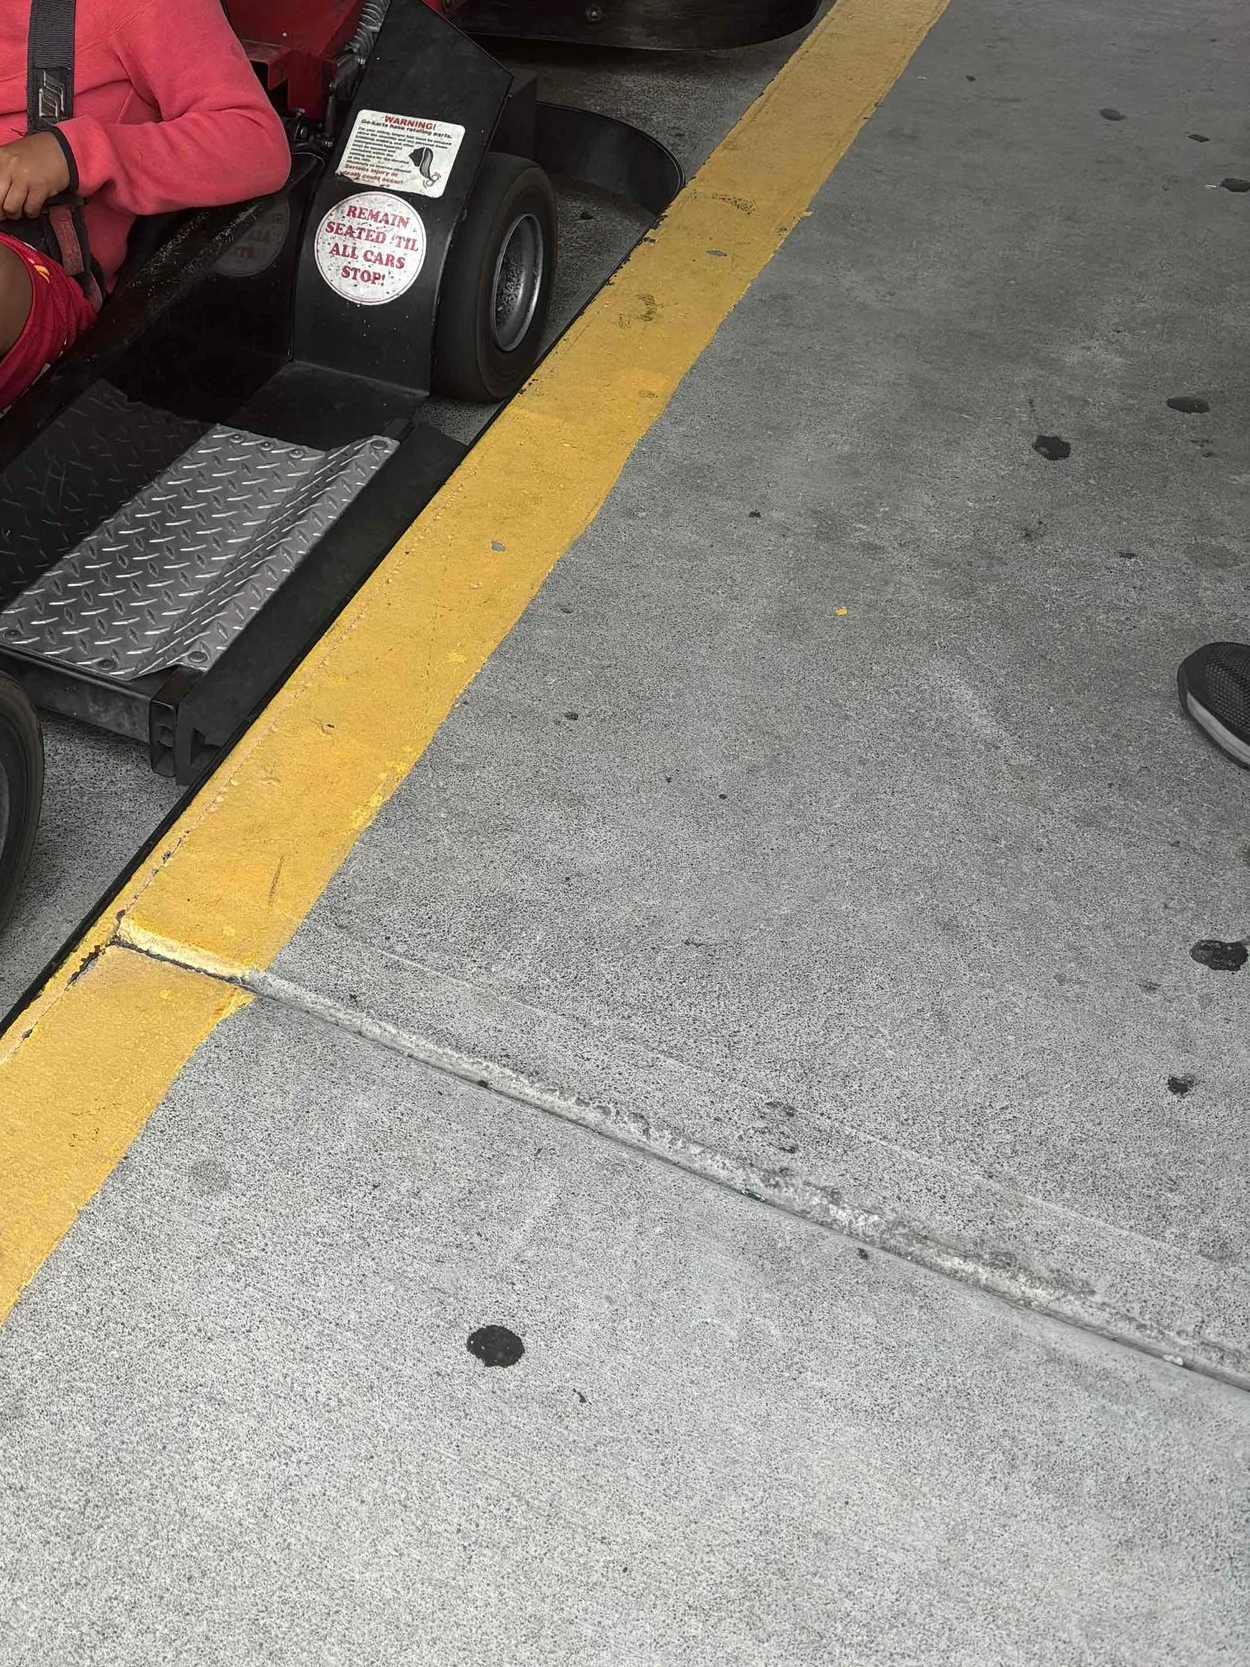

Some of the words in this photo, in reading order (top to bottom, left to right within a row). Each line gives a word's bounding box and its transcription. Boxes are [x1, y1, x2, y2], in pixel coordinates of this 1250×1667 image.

[360, 118, 389, 127] Go-karts
[405, 126, 432, 135] rotating
[432, 131, 453, 139] parts.
[382, 115, 437, 130] WARNING!
[346, 205, 410, 229] REMAIN
[325, 221, 386, 245] SEATED
[391, 234, 419, 252] 'TIL
[329, 242, 359, 260] ALL
[363, 249, 405, 270] CARS
[340, 264, 386, 287] STOP!
